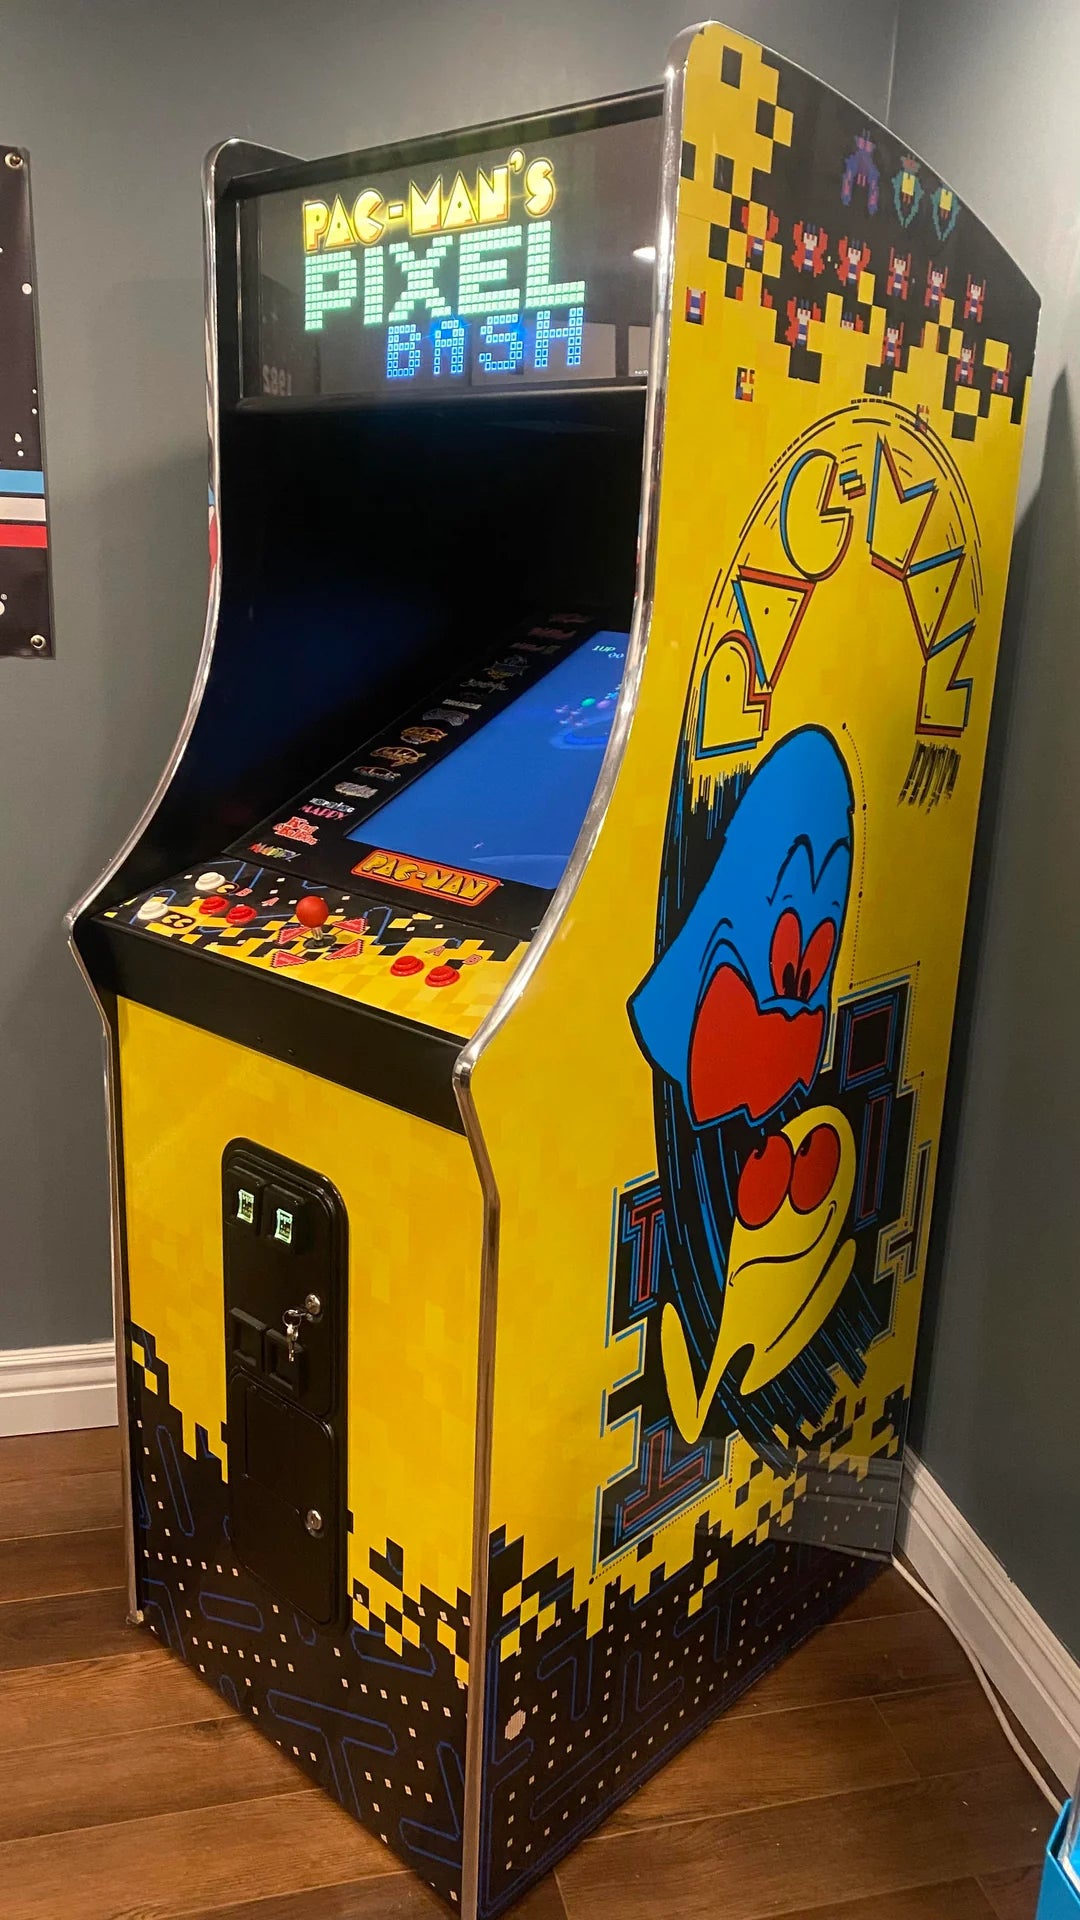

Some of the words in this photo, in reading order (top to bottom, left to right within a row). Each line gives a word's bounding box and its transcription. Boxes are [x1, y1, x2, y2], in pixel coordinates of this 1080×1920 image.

[303, 148, 555, 253] PAC-MAN'S
[304, 220, 586, 331] PIXEL
[386, 306, 584, 379] BASH
[299, 804, 351, 820] MAPPY
[361, 854, 489, 901] PAC-MAN
